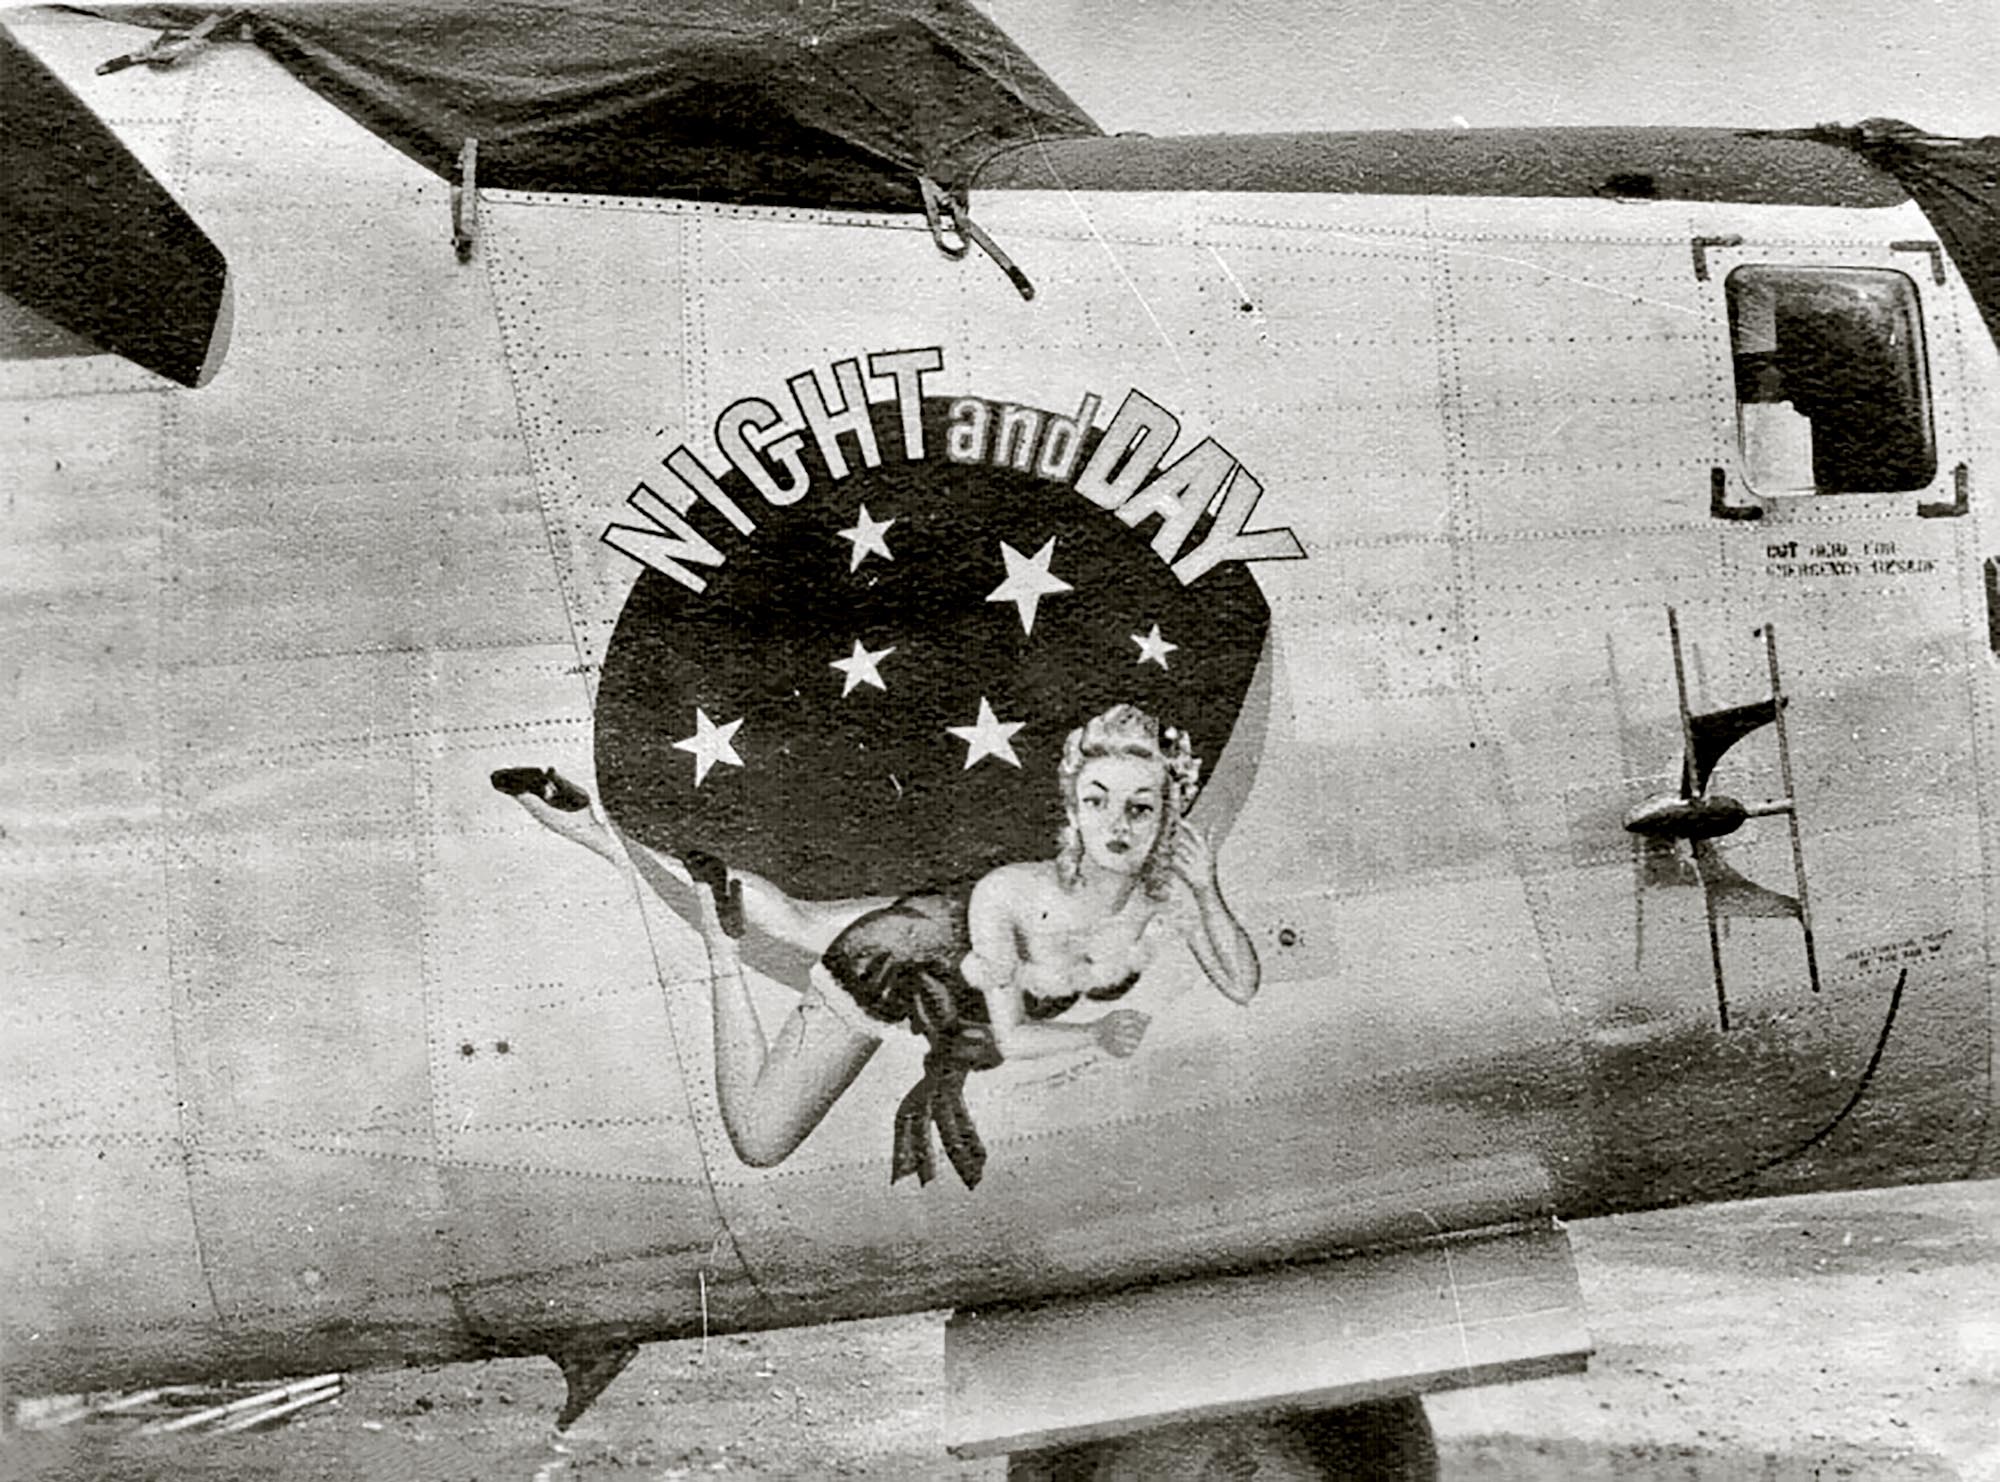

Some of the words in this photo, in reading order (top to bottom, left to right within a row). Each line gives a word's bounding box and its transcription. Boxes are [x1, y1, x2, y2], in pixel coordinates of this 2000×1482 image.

[600, 346, 943, 594] NIGHT
[945, 391, 1101, 484] and
[1073, 388, 1308, 587] DAY
[1766, 541, 1798, 558] CUT
